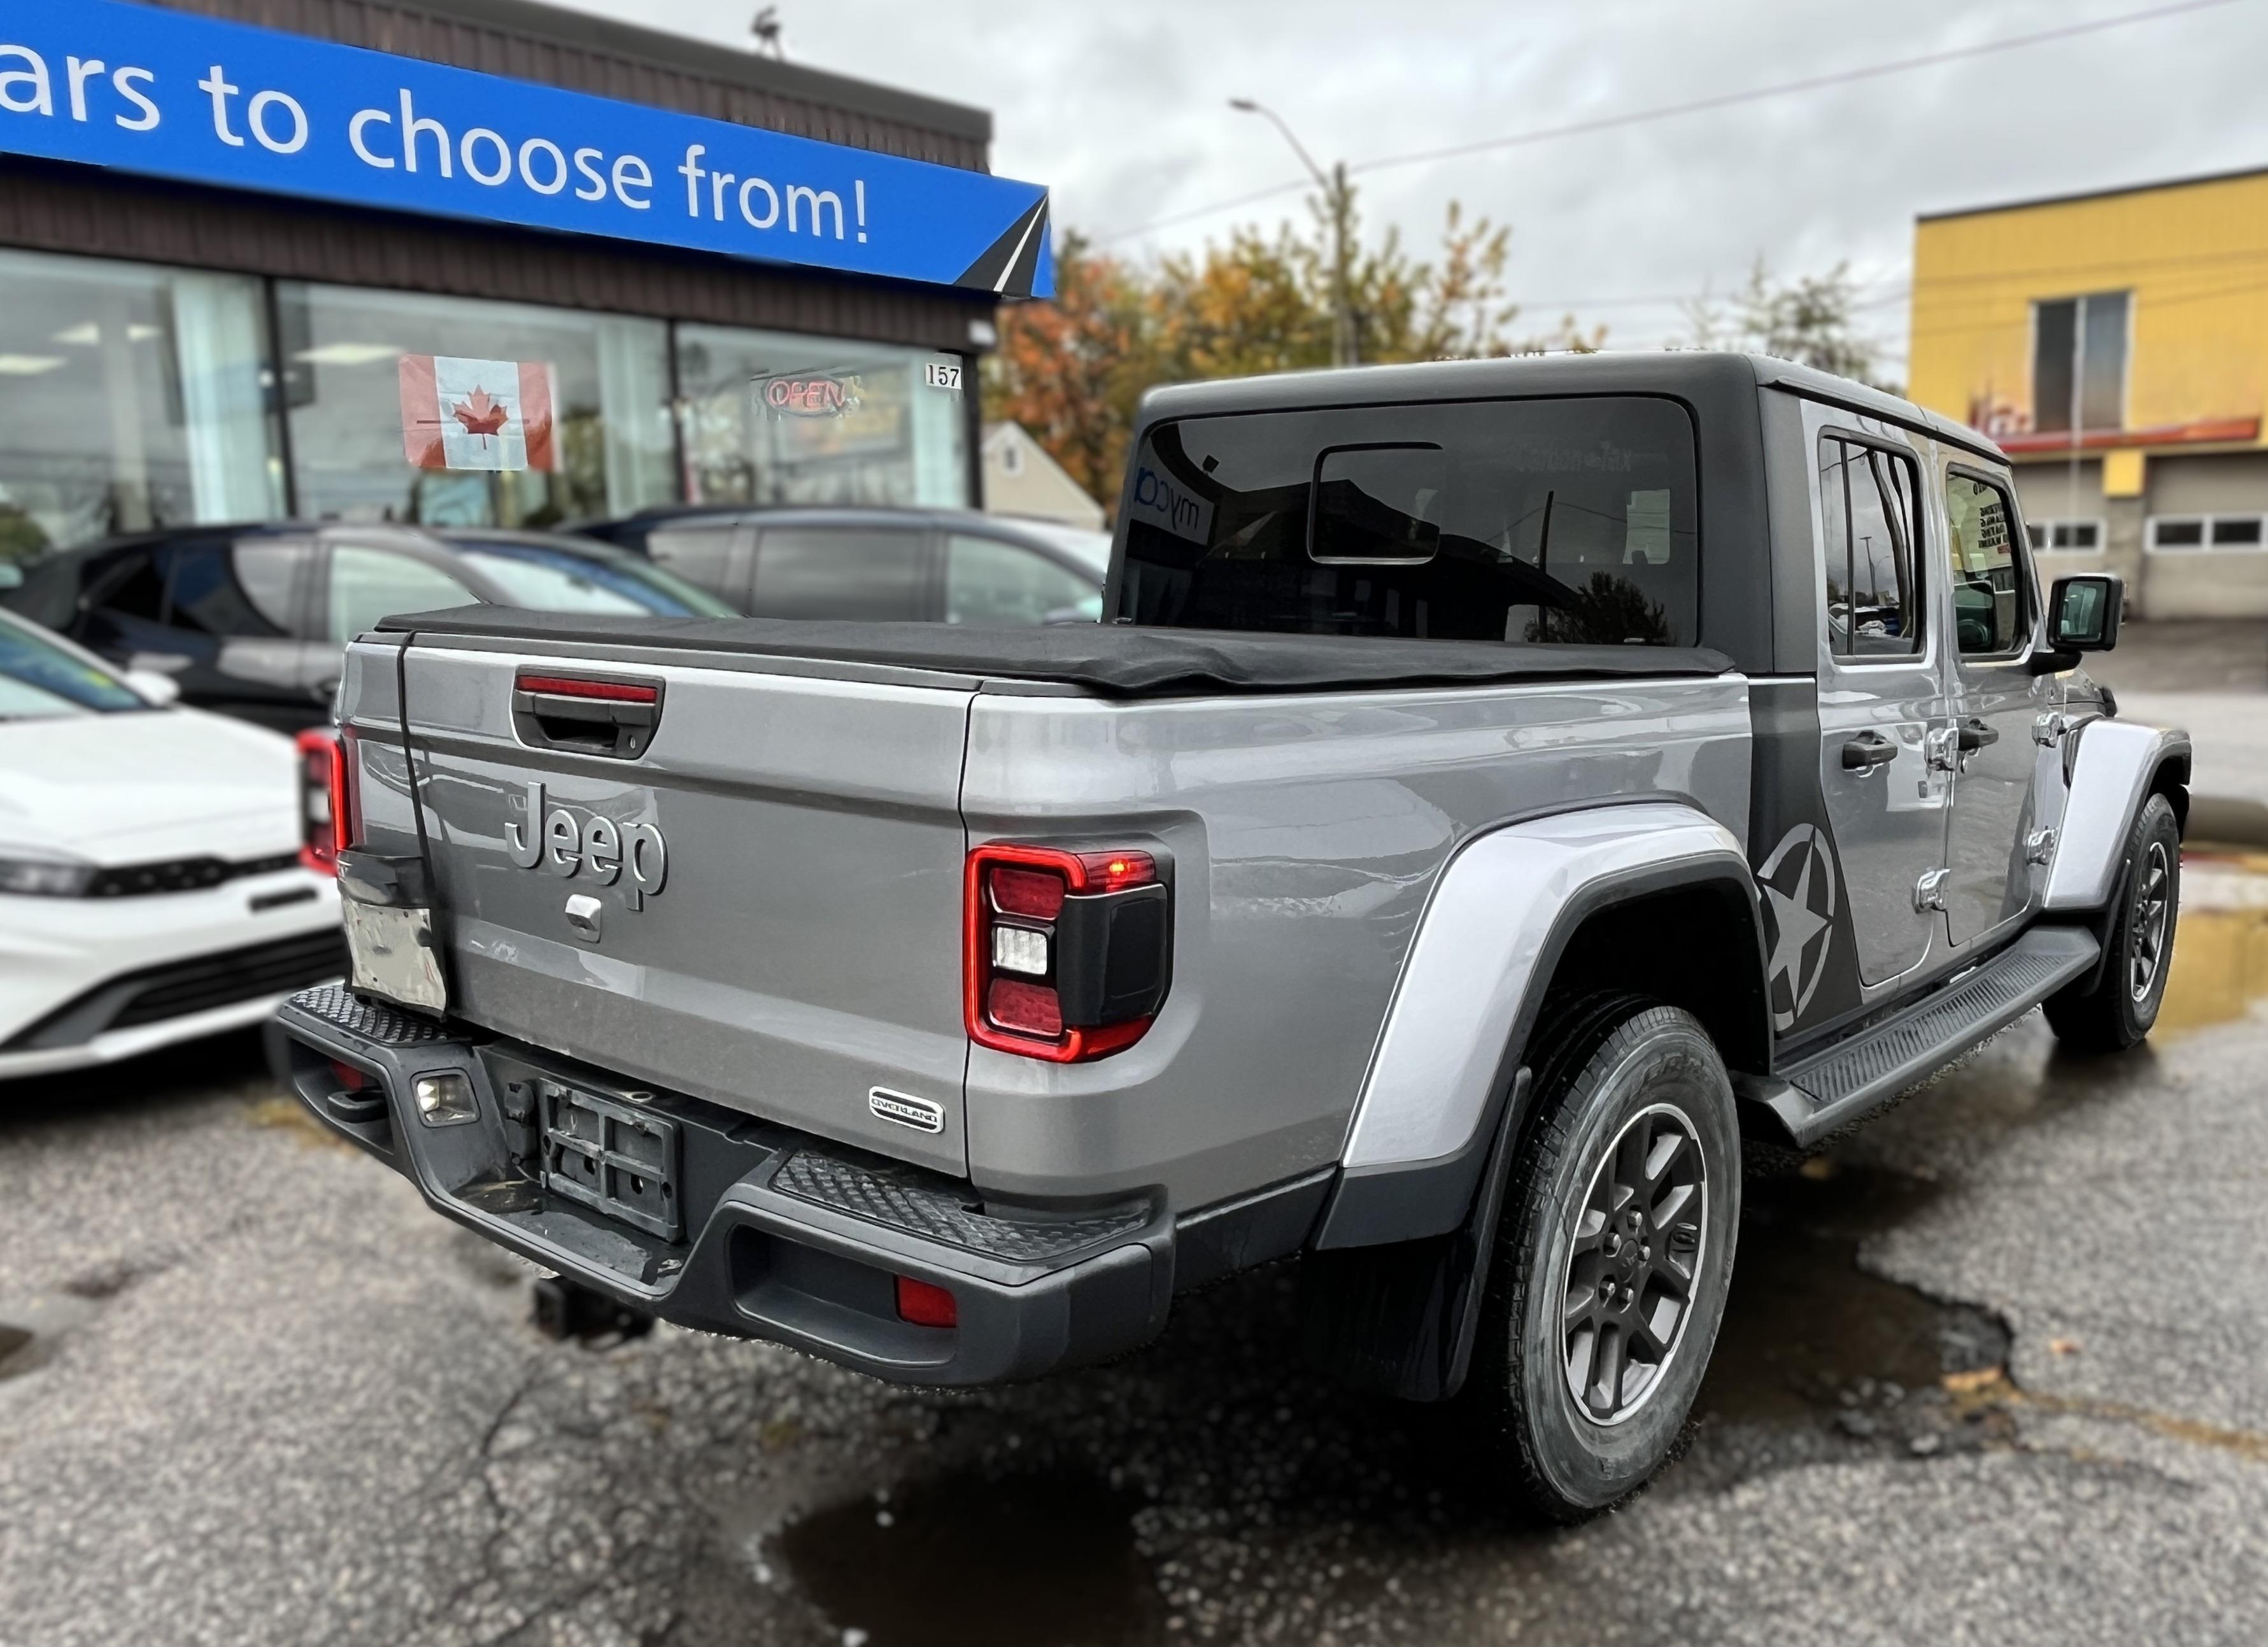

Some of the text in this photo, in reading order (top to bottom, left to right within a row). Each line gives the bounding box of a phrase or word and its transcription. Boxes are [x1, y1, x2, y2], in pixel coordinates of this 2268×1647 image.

[0, 45, 867, 243] ars to choose from!
[928, 364, 960, 388] 157
[769, 380, 846, 409] OPEN
[505, 782, 669, 912] Jeep
[871, 1098, 937, 1122] OVERLAND
